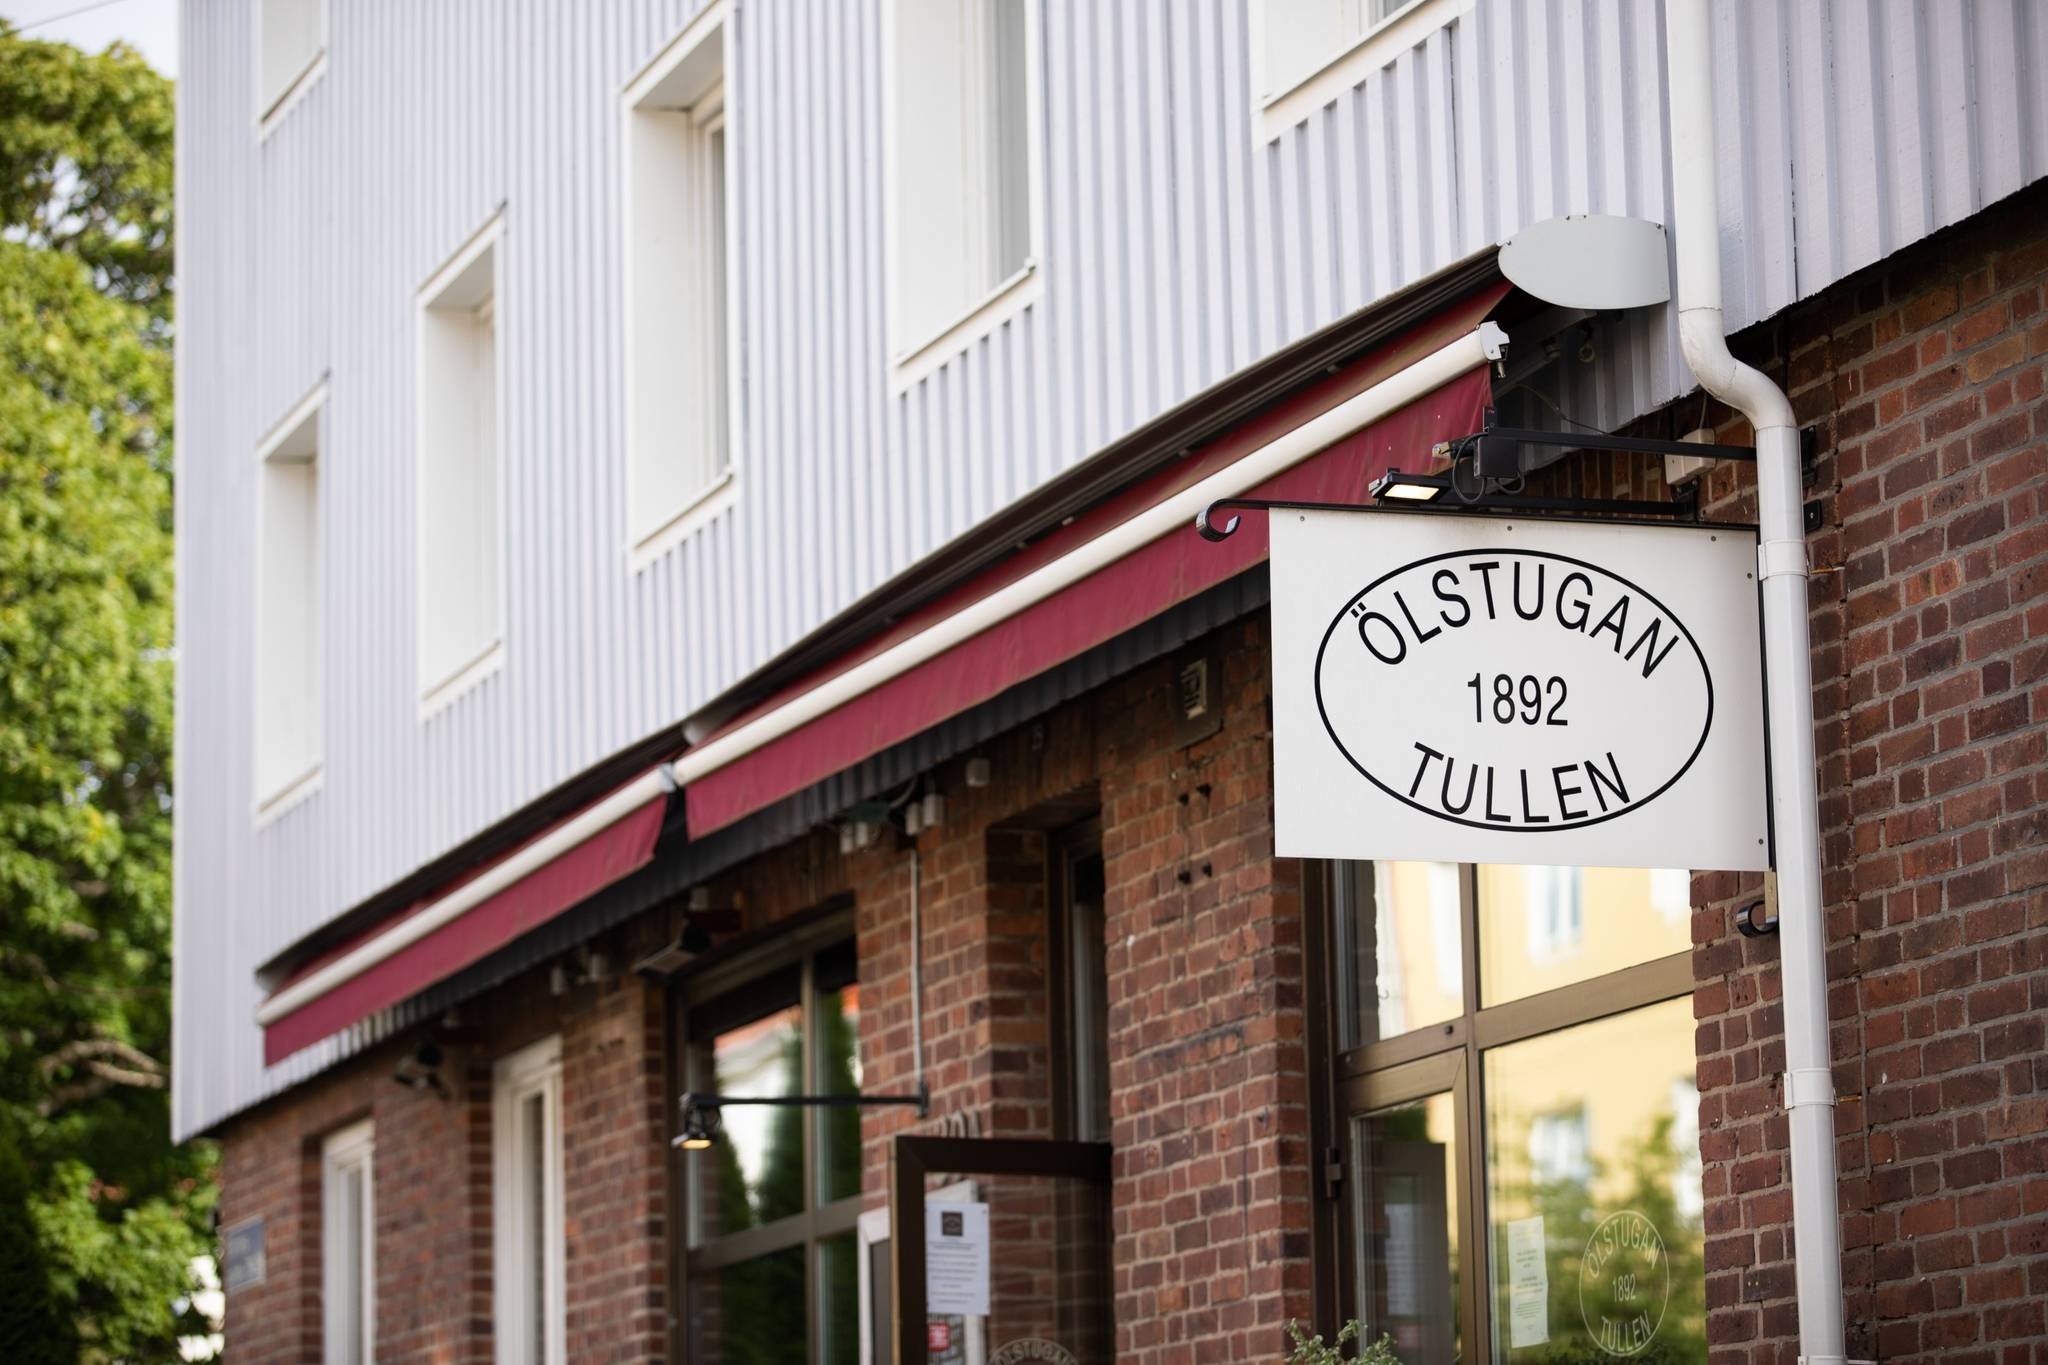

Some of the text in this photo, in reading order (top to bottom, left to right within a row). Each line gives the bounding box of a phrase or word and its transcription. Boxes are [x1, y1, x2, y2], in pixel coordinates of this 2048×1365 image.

[1350, 561, 1680, 679] ÖLSTUGAN
[1467, 672, 1568, 726] 1892
[1408, 741, 1631, 824] TULLEN
[1586, 1215, 1661, 1279] ÖLSTUGAN
[1612, 1273, 1637, 1302] 1892
[1601, 1309, 1651, 1352] TULLEN
